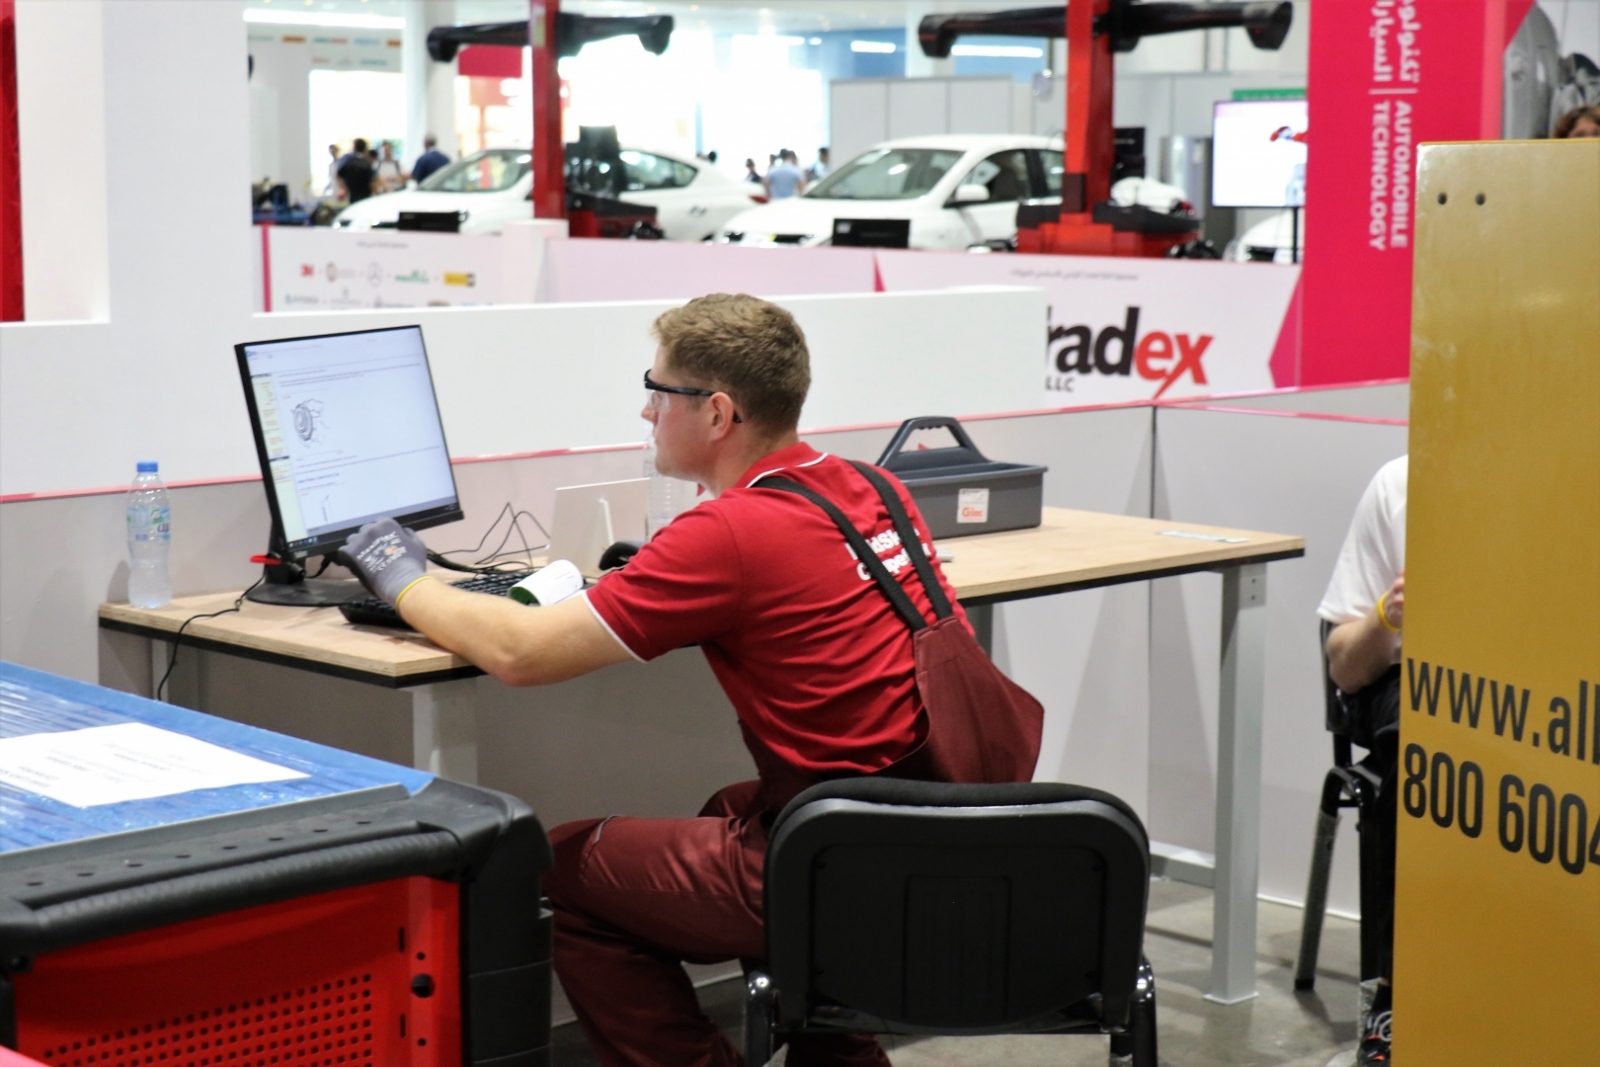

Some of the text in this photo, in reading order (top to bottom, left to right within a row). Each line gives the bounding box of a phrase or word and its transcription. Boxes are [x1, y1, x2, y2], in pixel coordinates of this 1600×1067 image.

[1397, 0, 1422, 83] تكنولو
[1369, 100, 1391, 251] TECHNOLOGY
[1390, 101, 1413, 248] AUTOMOBILE
[1046, 304, 1214, 400] radex
[1046, 376, 1075, 393] LLC
[1403, 742, 1484, 839] 800
